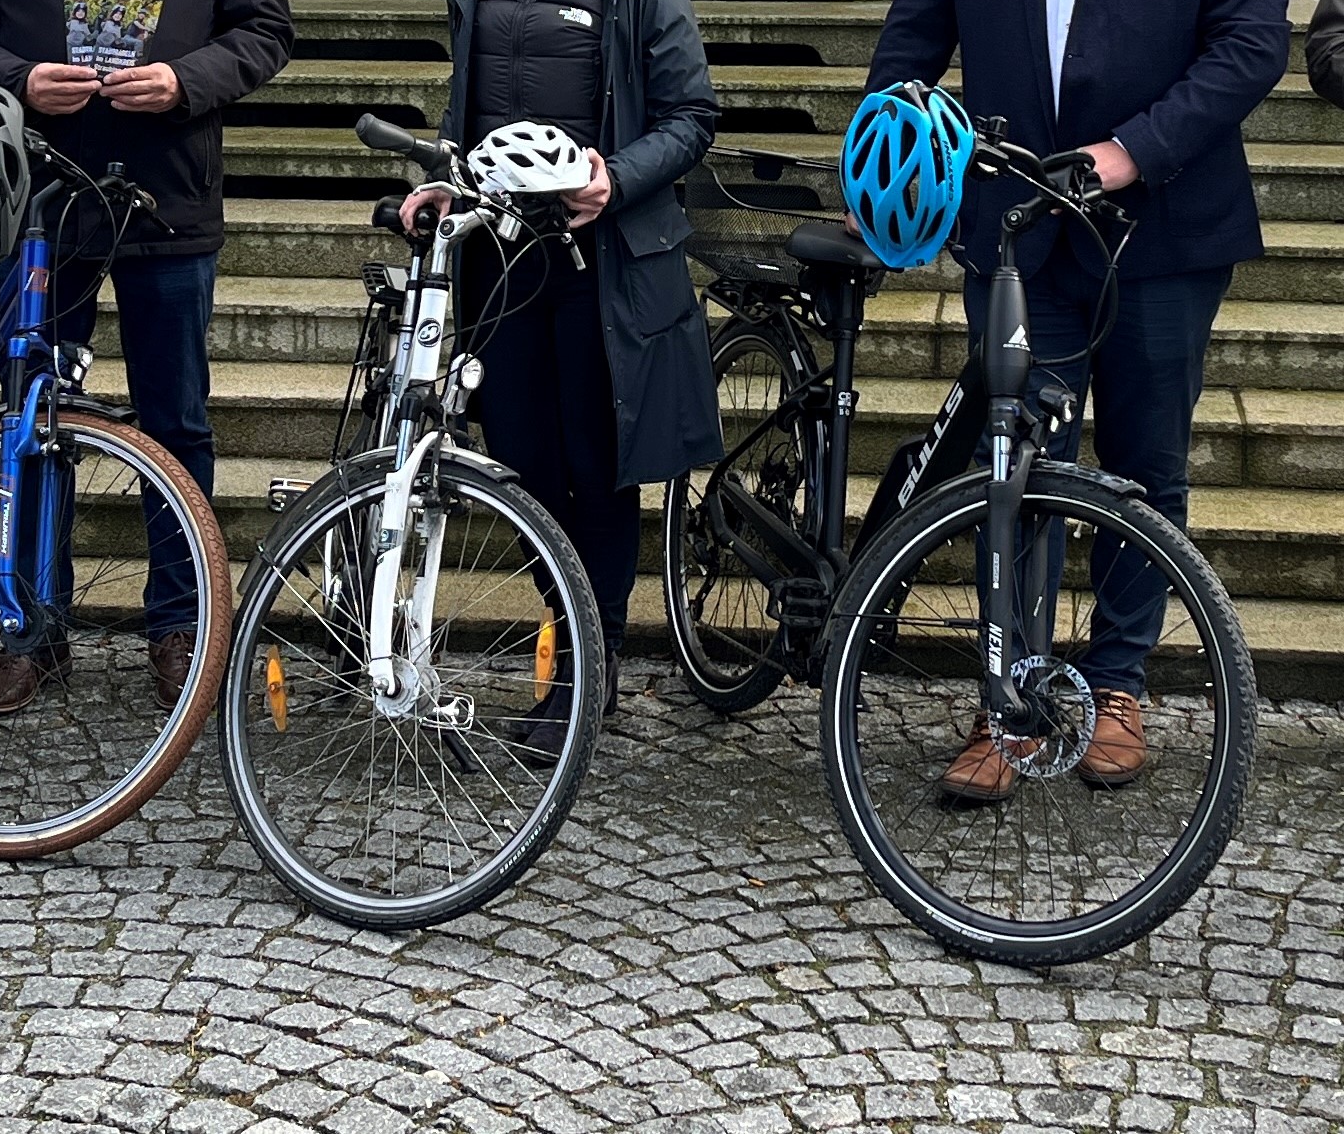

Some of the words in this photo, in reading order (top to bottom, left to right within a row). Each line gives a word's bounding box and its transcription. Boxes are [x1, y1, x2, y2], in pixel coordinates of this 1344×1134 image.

[942, 140, 955, 202] CRATONI
[898, 381, 965, 510] BULLS
[0, 501, 11, 555] TRIUMPH
